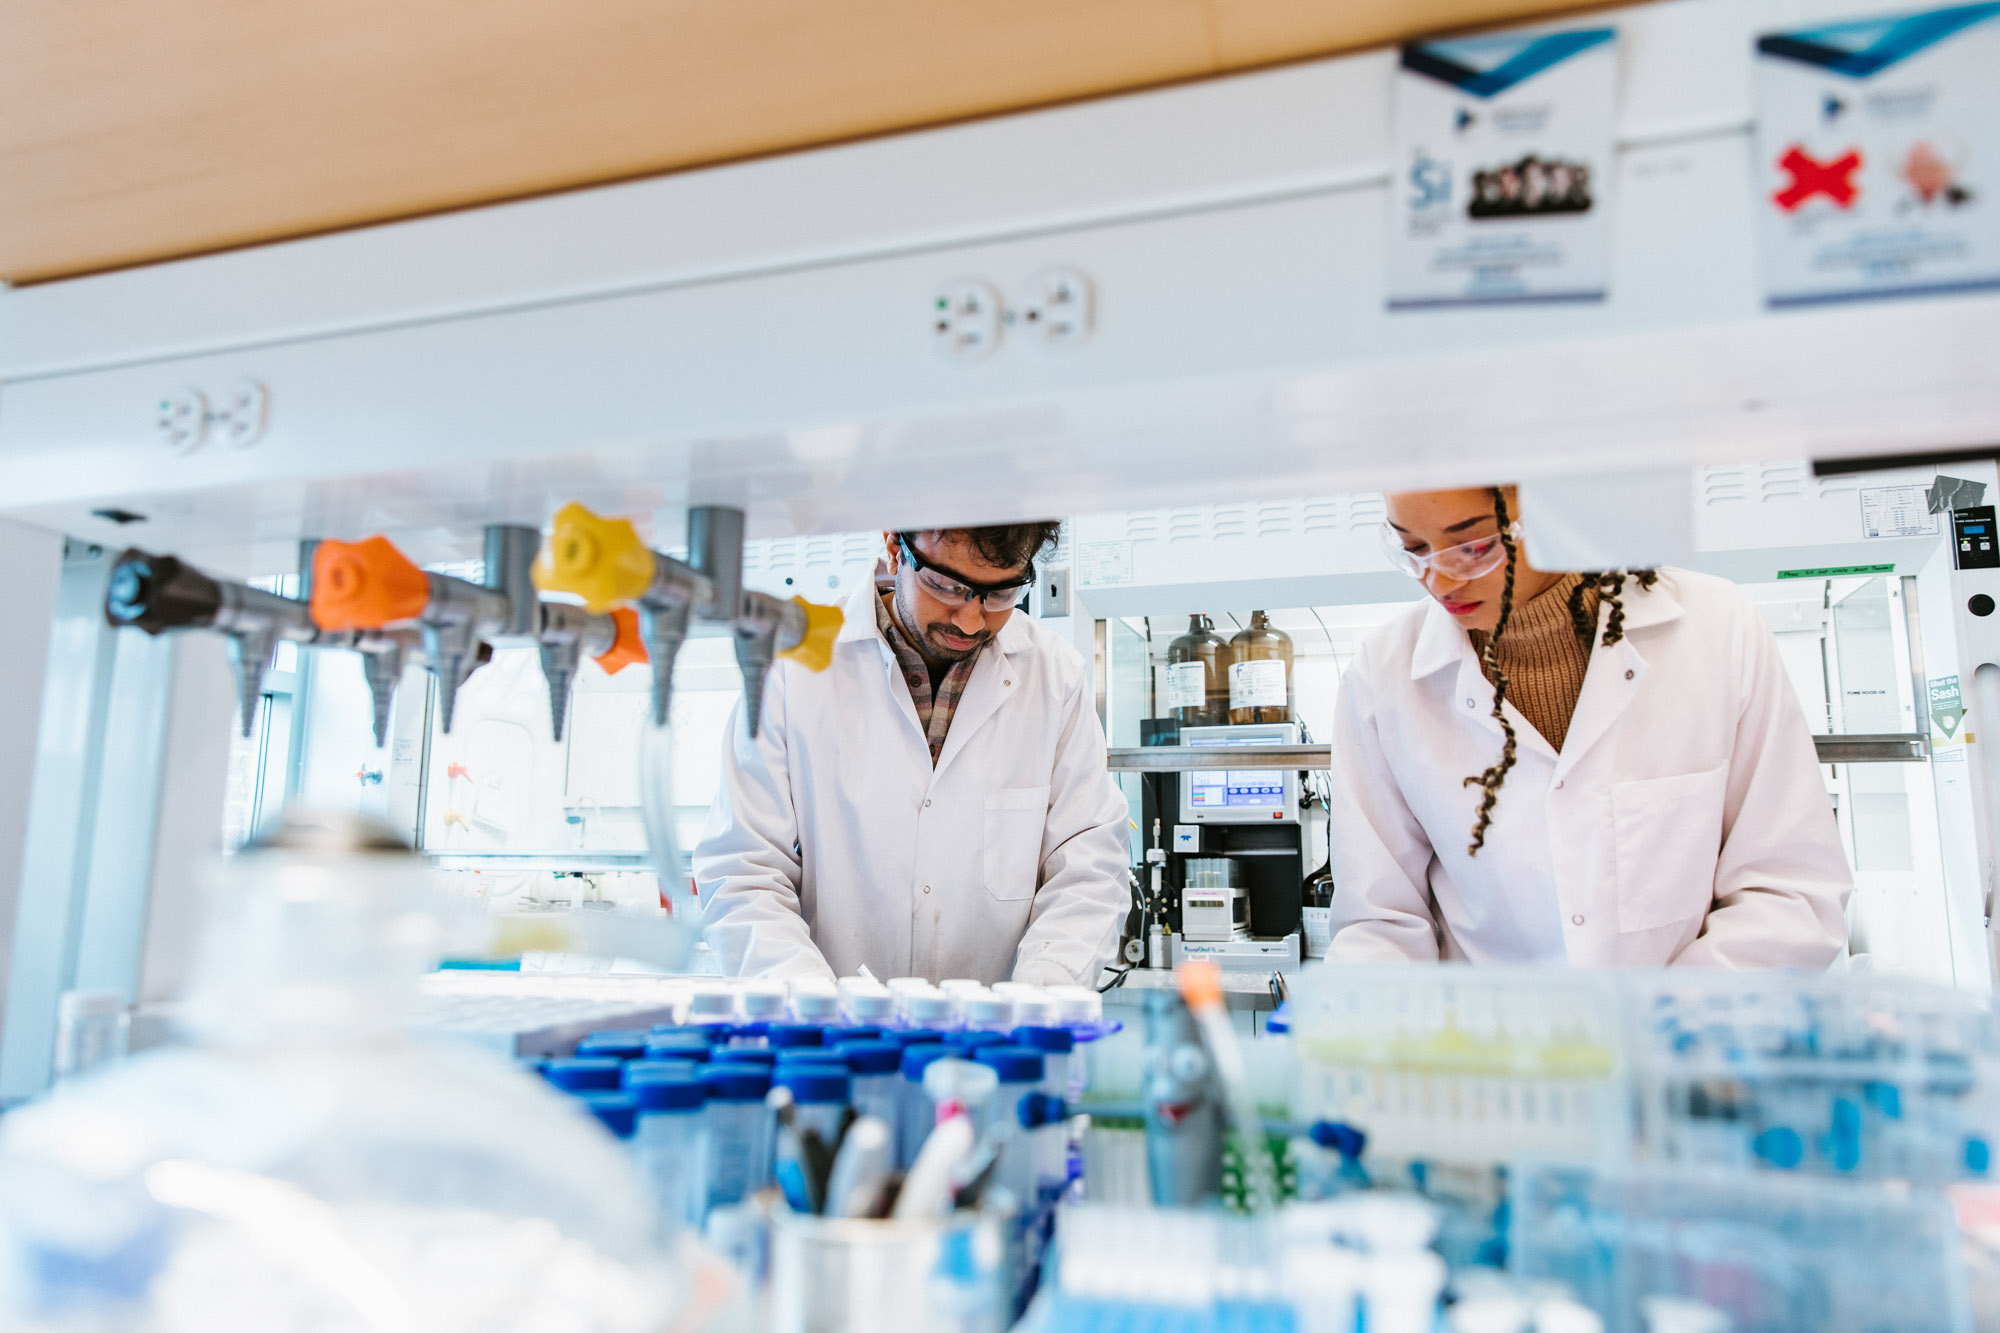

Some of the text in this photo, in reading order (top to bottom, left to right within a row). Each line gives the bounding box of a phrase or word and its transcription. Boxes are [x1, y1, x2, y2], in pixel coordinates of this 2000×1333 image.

[1930, 677, 1957, 688] Shut the
[1931, 686, 1959, 701] Sash
